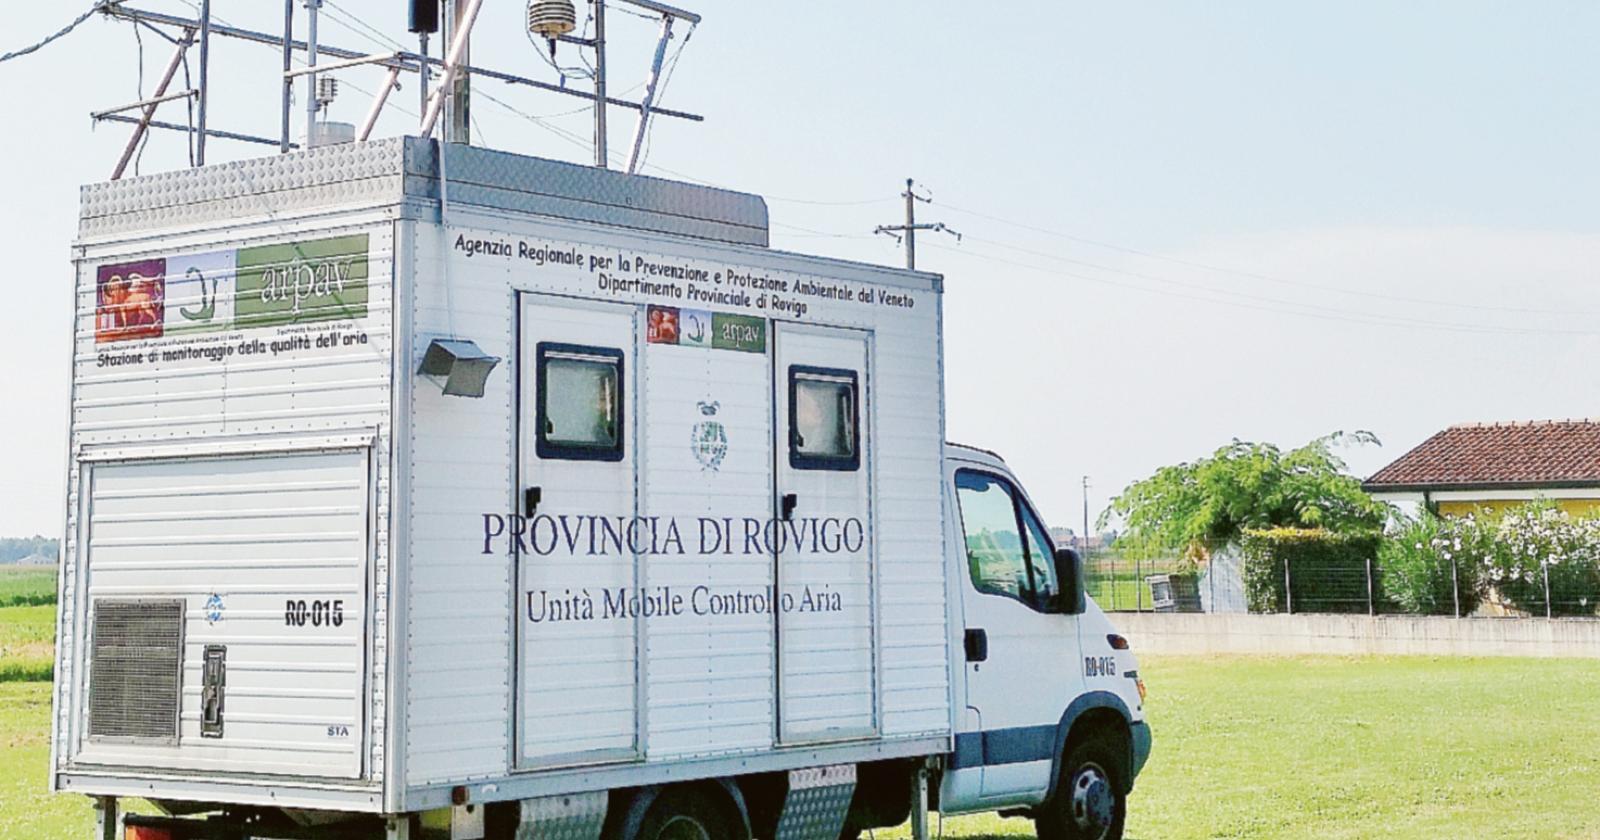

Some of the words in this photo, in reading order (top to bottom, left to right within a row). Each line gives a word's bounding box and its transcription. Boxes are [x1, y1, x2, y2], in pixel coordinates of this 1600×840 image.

[262, 257, 352, 316] arpav
[455, 234, 512, 257] Agenzia
[518, 240, 584, 266] Regionale
[590, 254, 613, 273] per
[618, 254, 630, 272] la
[635, 258, 708, 283] Prevenzione
[714, 271, 721, 284] e
[727, 269, 788, 292] Protezione
[793, 279, 853, 301] Ambientale
[858, 288, 874, 304] del
[878, 290, 914, 309] Veneto
[598, 273, 682, 300] Dipartimento
[687, 284, 750, 308] Provinciale
[756, 293, 767, 309] di
[772, 295, 807, 318] Rovigo
[97, 353, 143, 367] Stazione
[148, 350, 158, 363] di
[163, 343, 233, 361] monitoraggio
[238, 339, 266, 355] della
[270, 334, 310, 356] qualità
[316, 330, 368, 349] dell'aria
[722, 322, 760, 347] arpav
[481, 513, 685, 556] PROVINCIA
[697, 517, 732, 555] DI
[742, 517, 864, 555] ROVIGO
[526, 588, 594, 623] Unità
[602, 586, 683, 619] Mobile
[799, 583, 842, 612] Aria
[327, 725, 349, 737] STA
